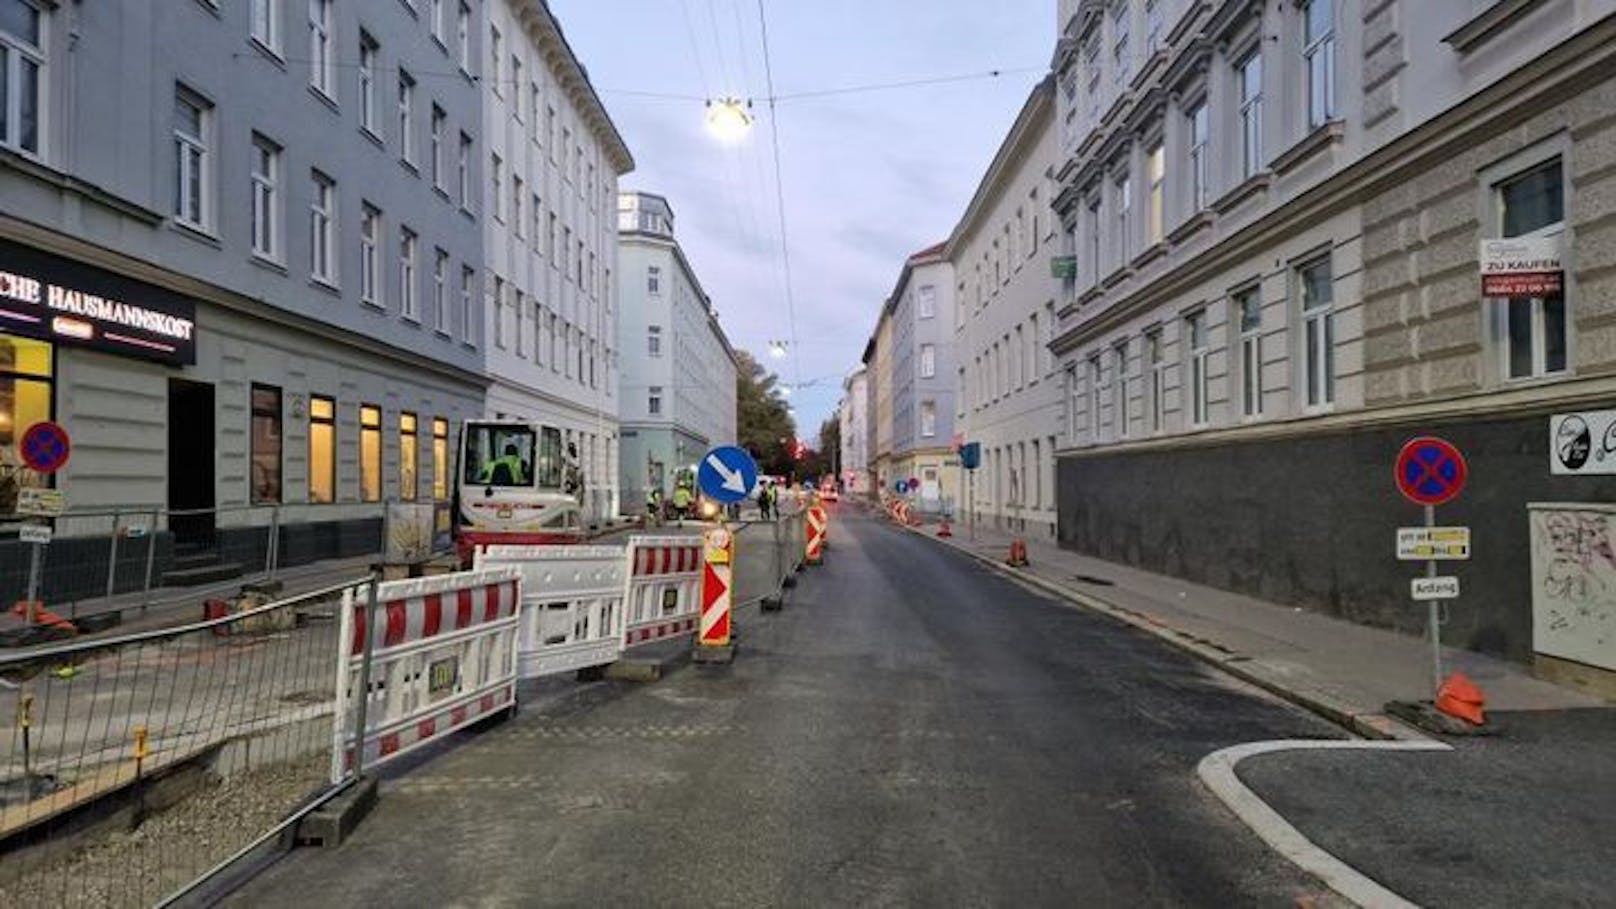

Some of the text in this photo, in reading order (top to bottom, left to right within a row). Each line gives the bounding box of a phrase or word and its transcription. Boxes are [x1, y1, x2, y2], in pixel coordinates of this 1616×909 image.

[1487, 259, 1560, 270] ZU KAUFEN
[48, 284, 194, 341] HAUSMANNSKOST
